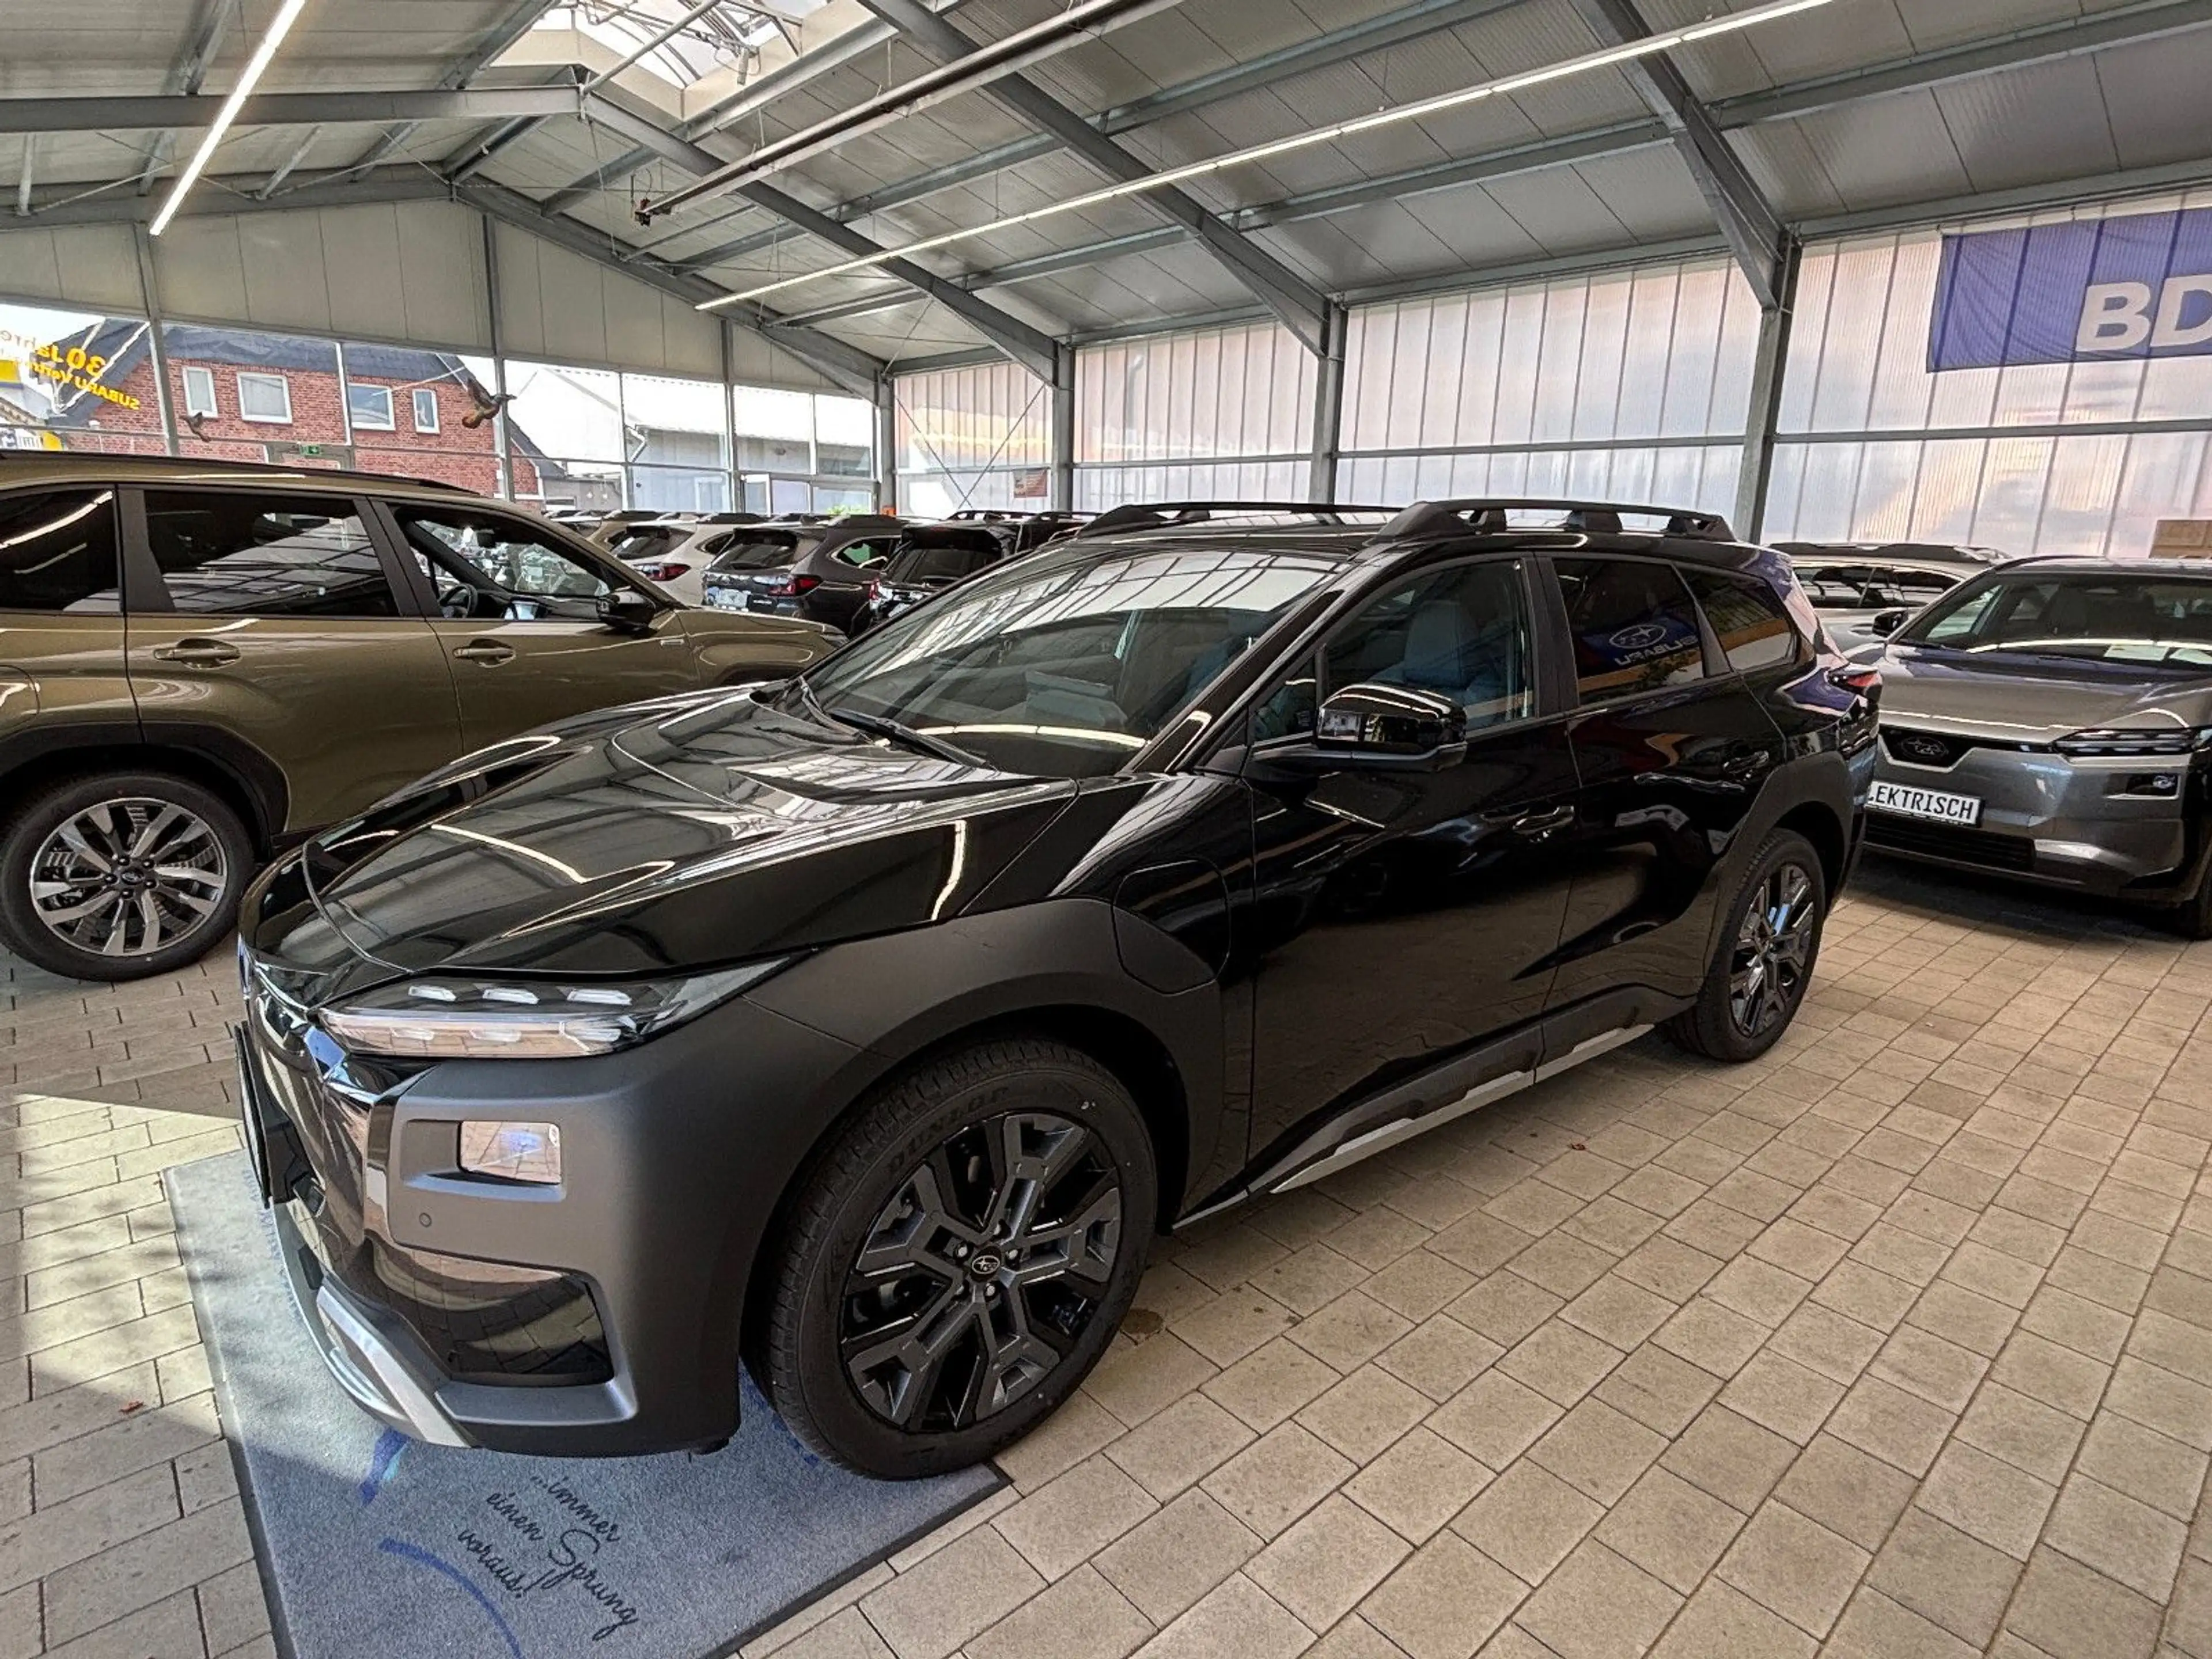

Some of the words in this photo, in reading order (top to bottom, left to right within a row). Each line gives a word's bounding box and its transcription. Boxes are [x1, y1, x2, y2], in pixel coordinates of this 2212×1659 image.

[2075, 274, 2212, 352] BD
[487, 1493, 543, 1541] einen
[540, 1529, 639, 1641] Sprung
